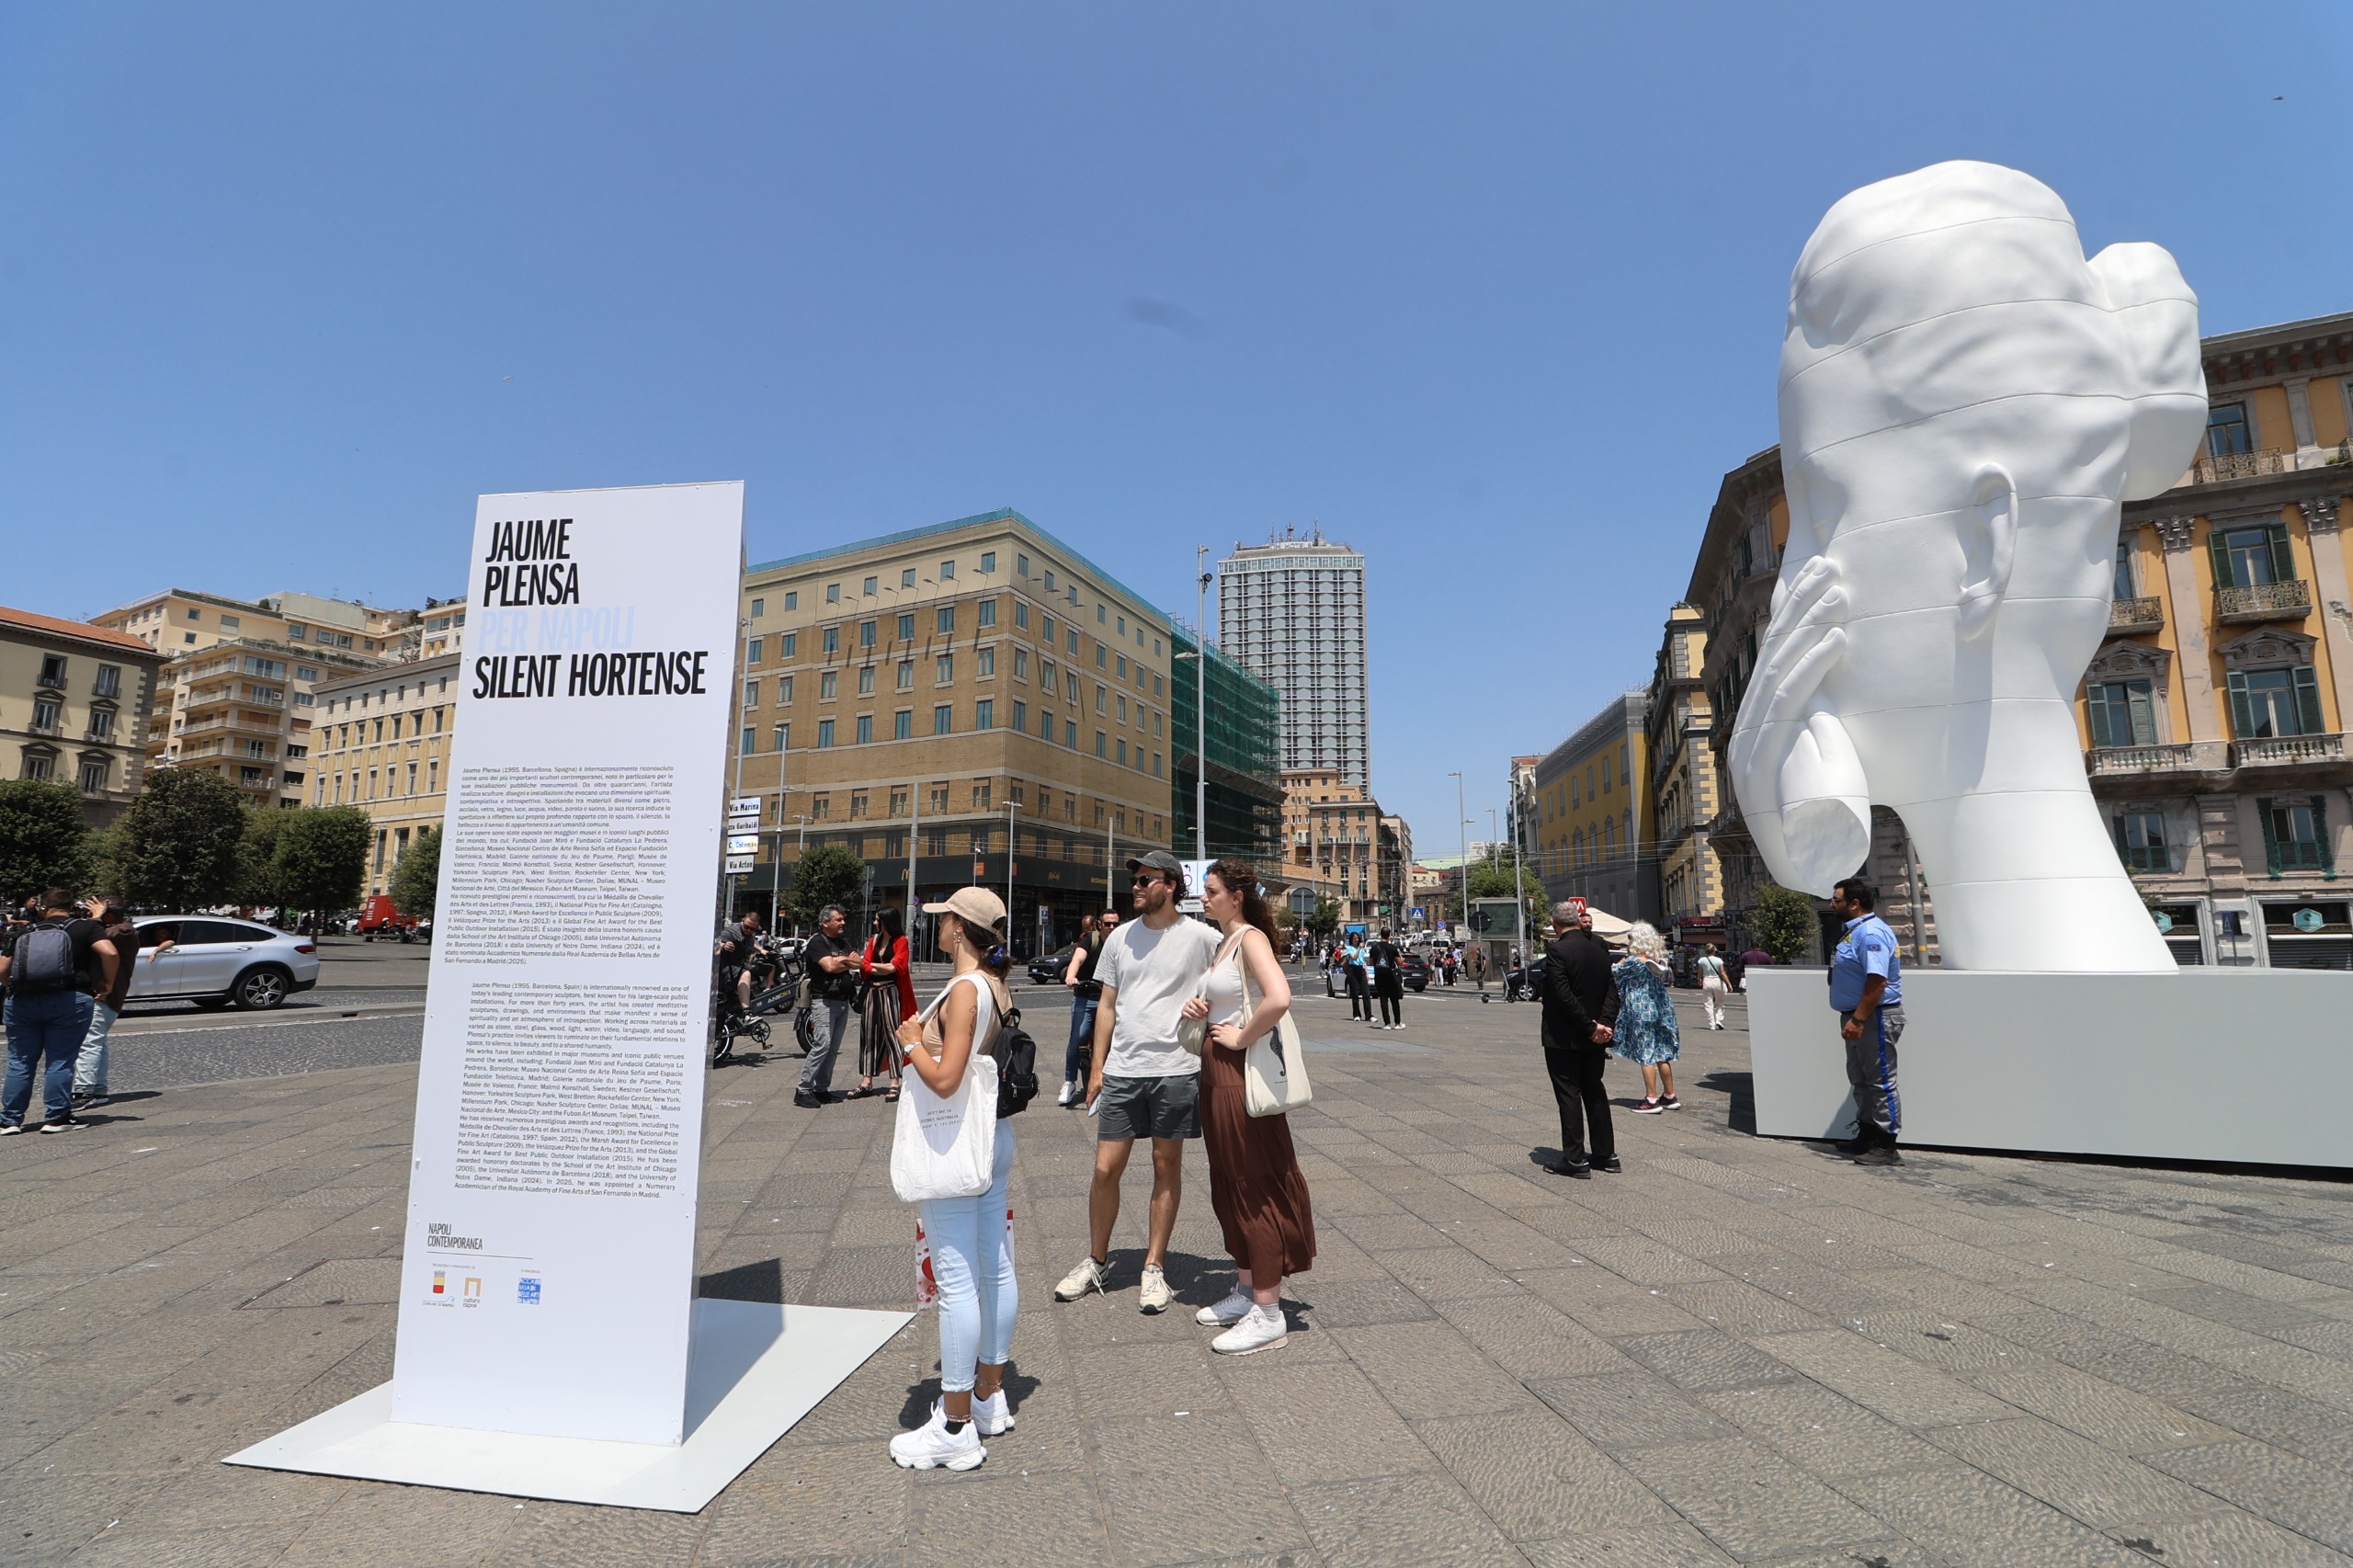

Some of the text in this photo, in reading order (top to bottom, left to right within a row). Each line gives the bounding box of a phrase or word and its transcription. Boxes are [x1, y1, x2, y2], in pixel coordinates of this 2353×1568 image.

[485, 518, 574, 562] JAUME
[483, 562, 579, 607] PLENSA
[479, 606, 635, 653] PER NAPOLI
[472, 651, 709, 699] SILENT HORTENSE
[532, 983, 562, 991] Barcelona,
[553, 999, 566, 1007] forty
[529, 1074, 550, 1083] Madrid;
[640, 1077, 663, 1085] Paume,
[665, 1078, 682, 1086] Paris;
[612, 1153, 633, 1163] (2015).
[428, 1222, 452, 1235] NAPOLI
[427, 1235, 483, 1250] CONTEMPORANEA
